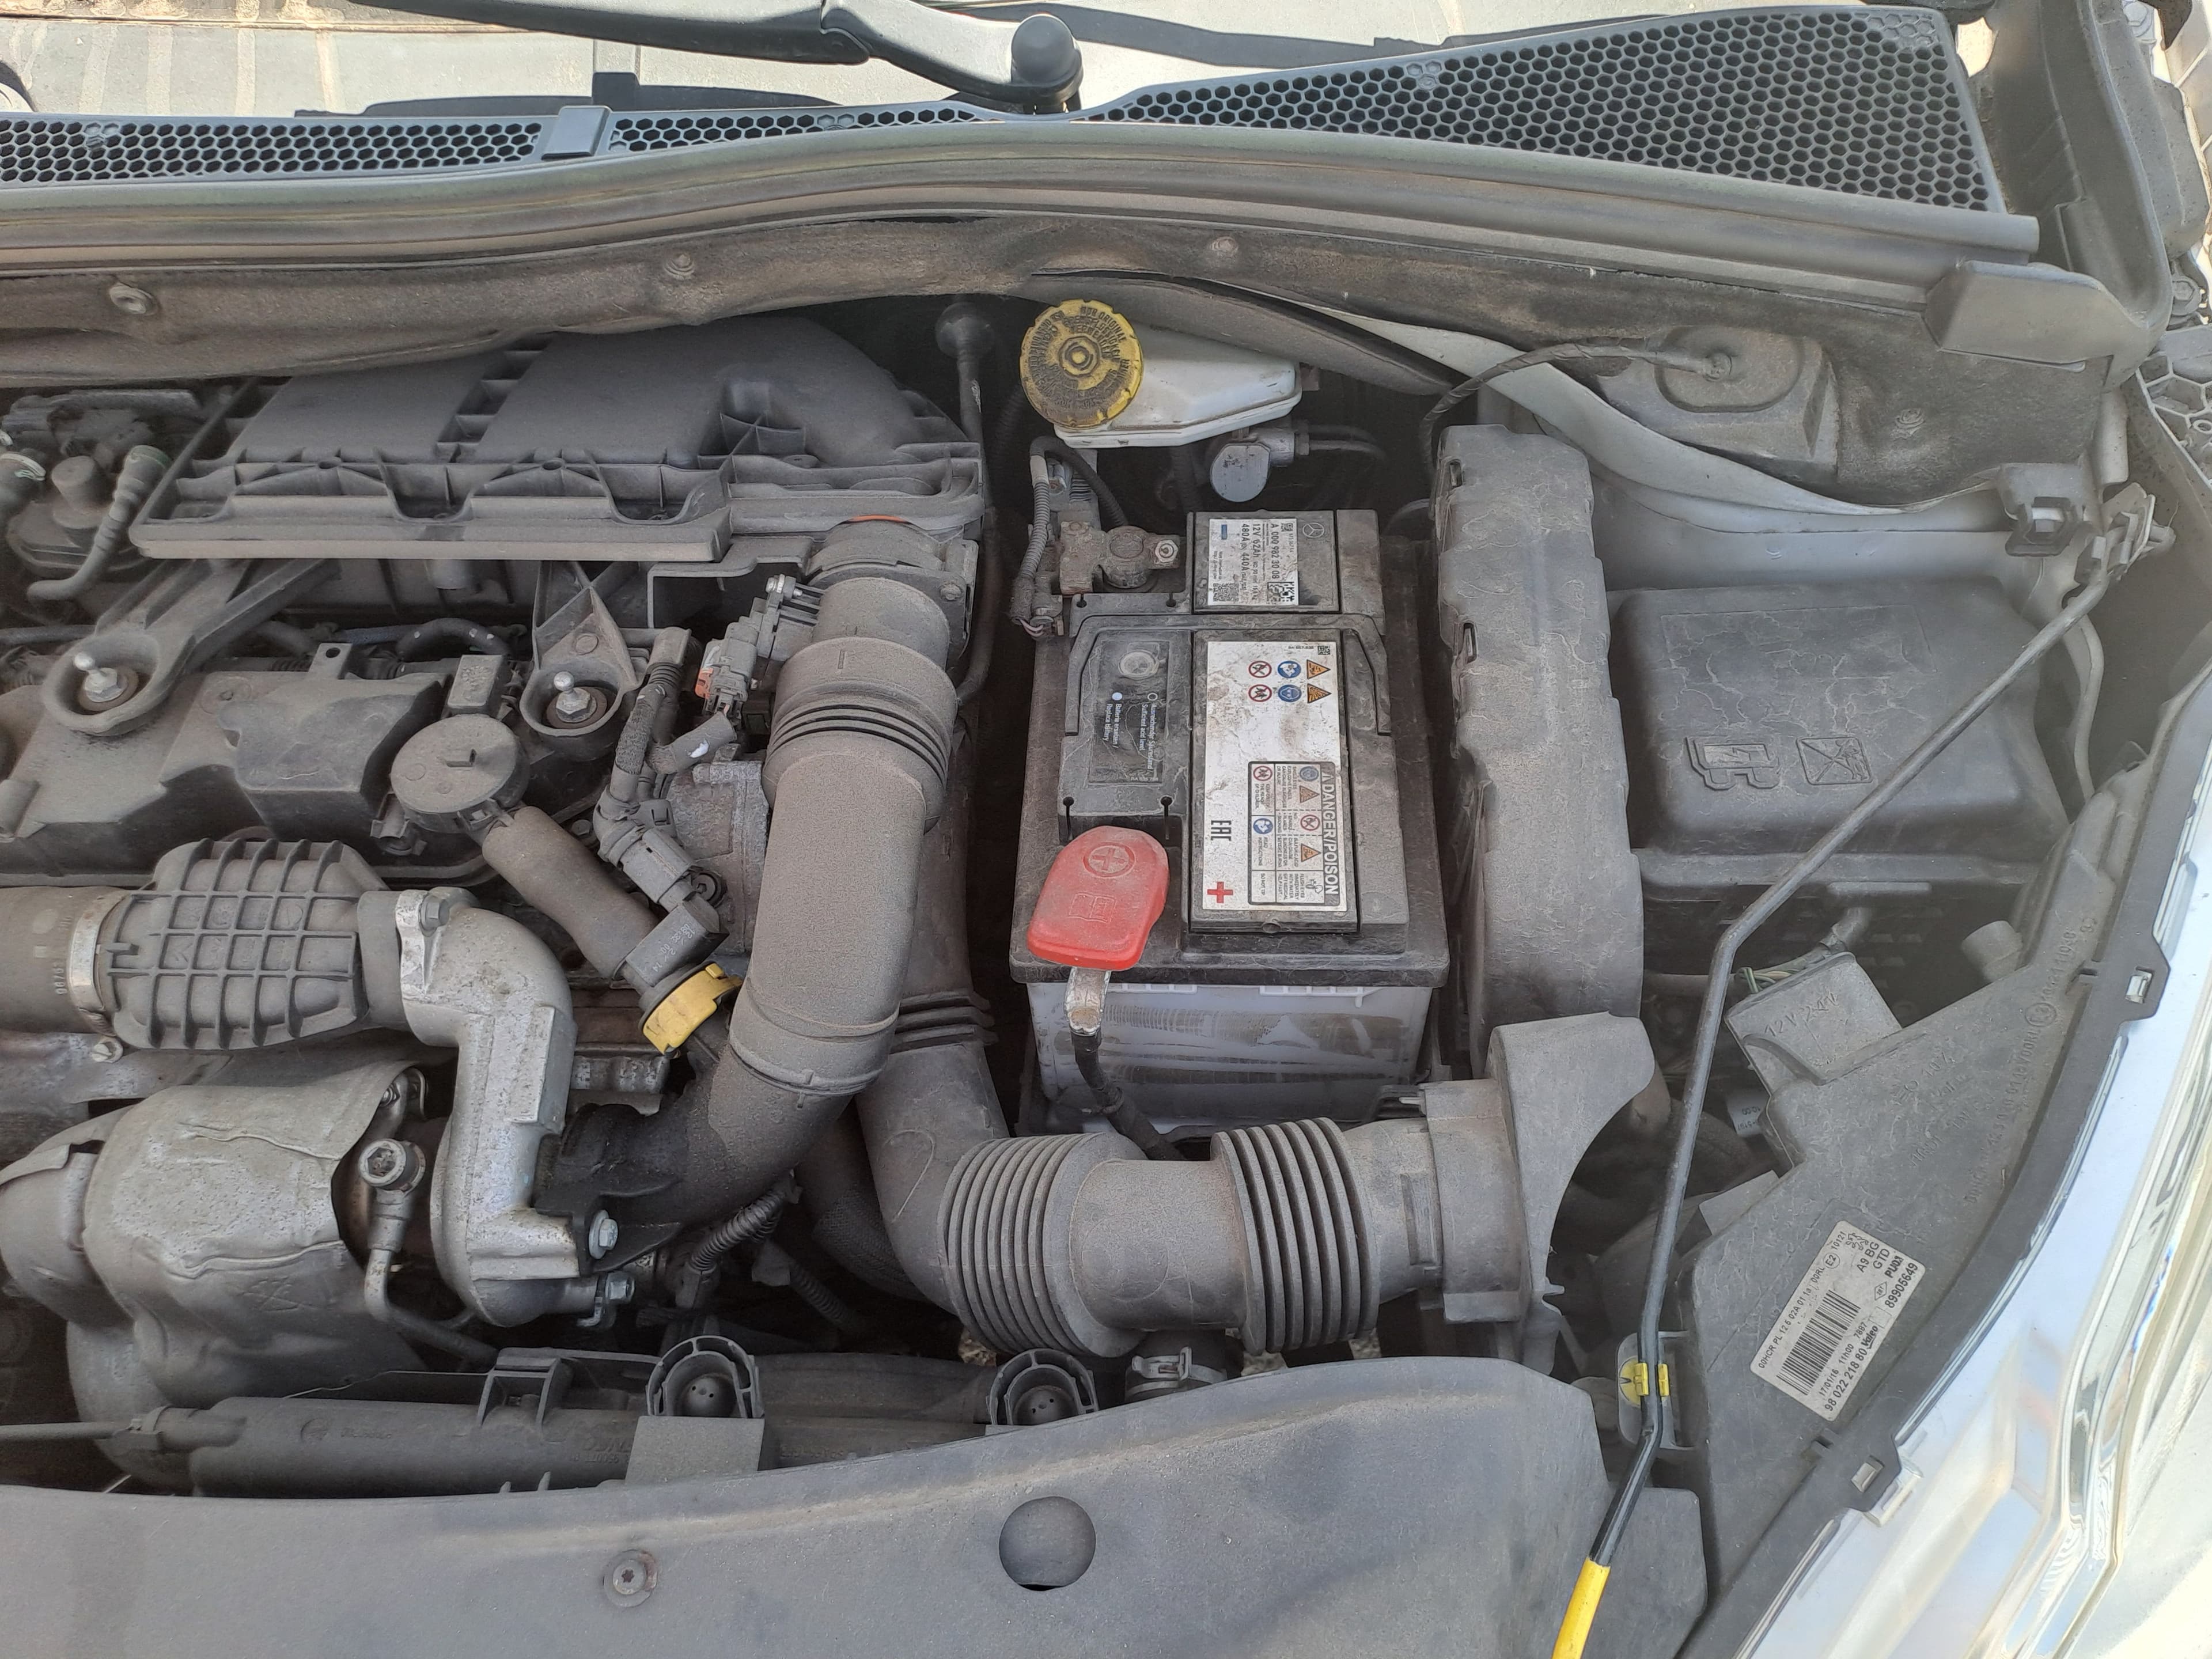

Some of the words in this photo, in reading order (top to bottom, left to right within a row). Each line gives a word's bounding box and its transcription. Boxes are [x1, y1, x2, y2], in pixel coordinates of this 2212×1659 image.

[1099, 312, 1127, 342] ORIGINAL
[1272, 570, 1279, 579] 08
[1322, 784, 1339, 895] DANGER/POISON
[1825, 1254, 1836, 1266] E2
[1857, 1257, 1869, 1271] A9
[1865, 1241, 1879, 1257] BG
[1873, 1248, 1890, 1269] GTD
[1885, 1262, 1918, 1308] 89905649
[1758, 1345, 1775, 1368] 00HCR
[1773, 1334, 1782, 1344] PL
[1788, 1305, 1800, 1319] 02A
[1797, 1296, 1805, 1305] 01
[1861, 1324, 1880, 1348] Valeo
[1819, 1368, 1839, 1396] 17/01/16
[1838, 1343, 1854, 1364] 11h00
[1824, 1398, 1836, 1411] 98
[1832, 1379, 1848, 1397] 022
[1844, 1361, 1859, 1378] 218
[1855, 1347, 1867, 1361] 80
